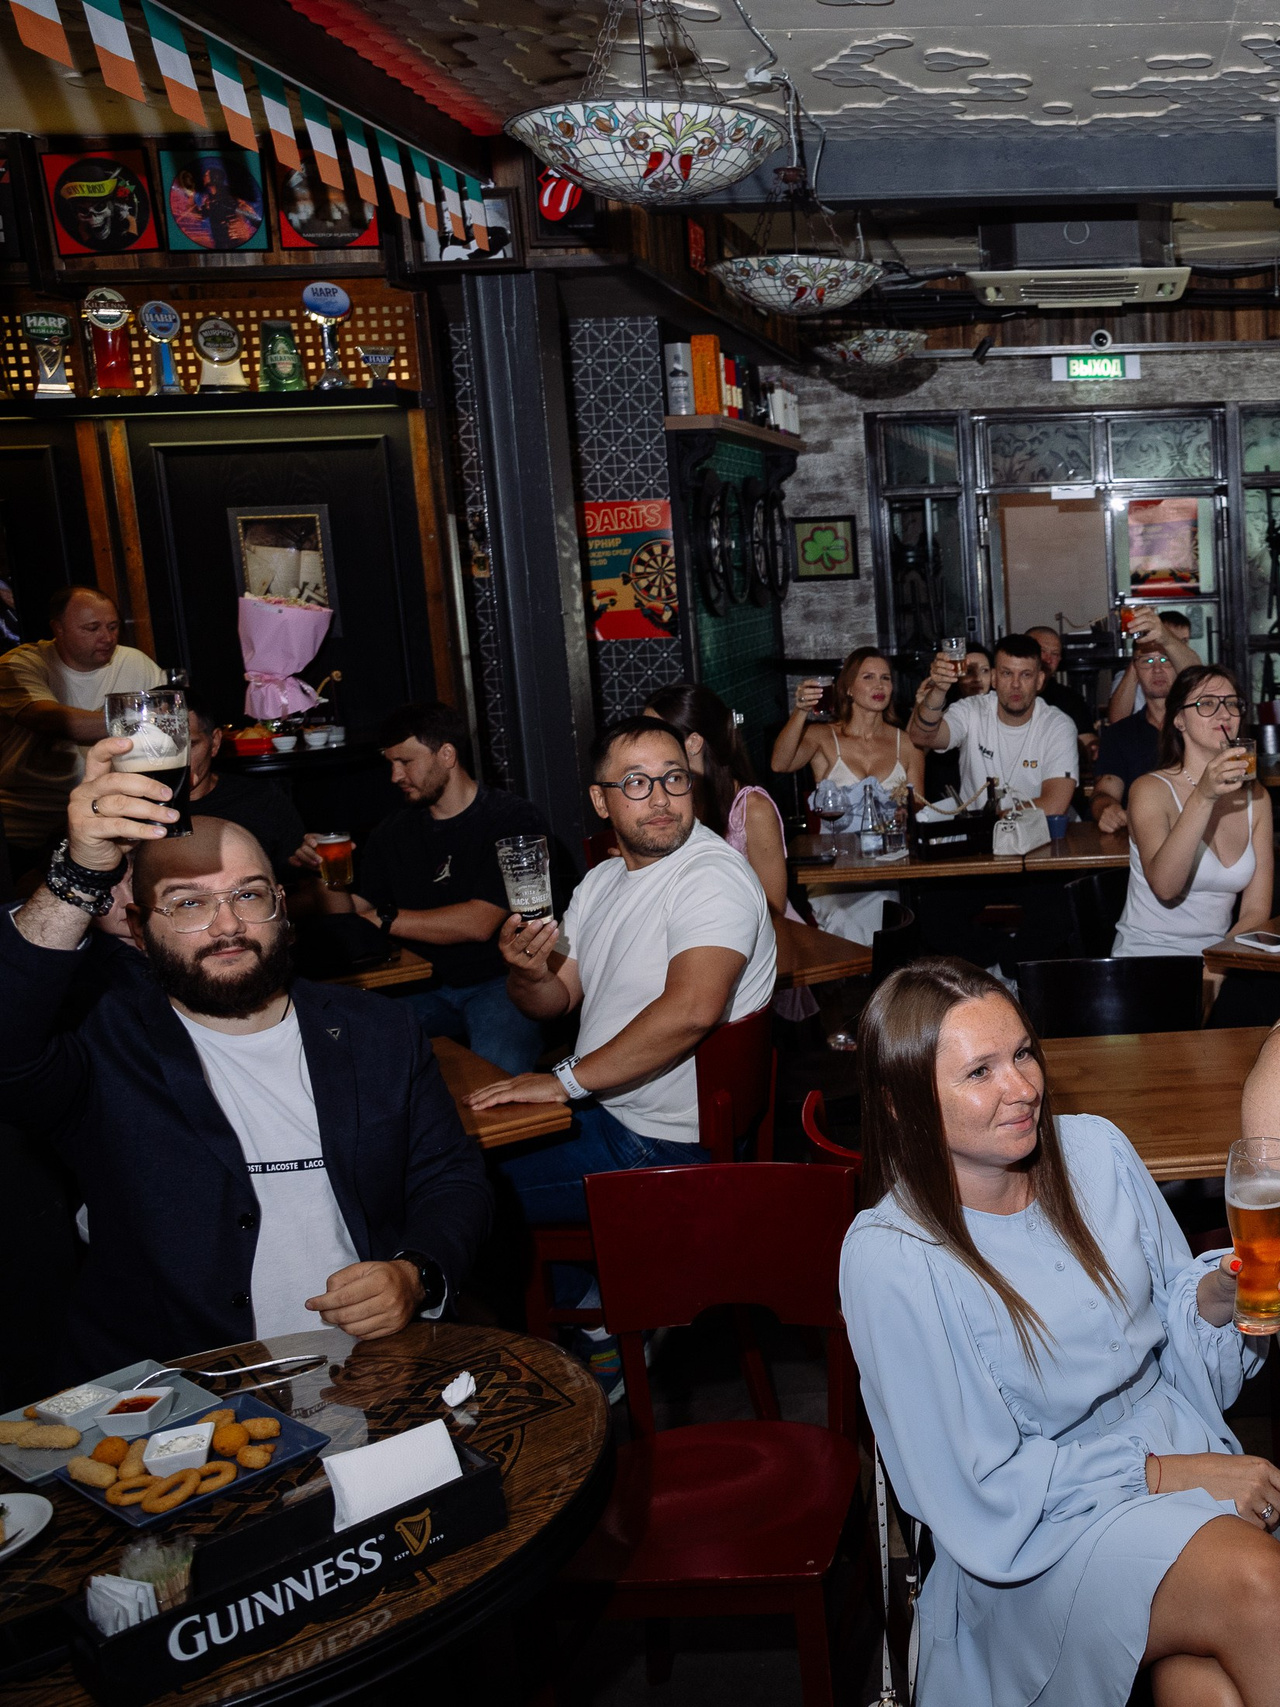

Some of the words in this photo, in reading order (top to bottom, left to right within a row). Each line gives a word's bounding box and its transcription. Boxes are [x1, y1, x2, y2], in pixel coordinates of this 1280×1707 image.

[311, 287, 338, 297] HARP
[83, 300, 129, 309] KILKENNY
[26, 315, 68, 328] HARP
[145, 312, 176, 323] HARP
[1069, 359, 1122, 377] ВЫХОД
[585, 503, 662, 534] DARTS
[266, 1161, 299, 1172] LACOSTE
[428, 1533, 445, 1545] 1759
[167, 1536, 383, 1662] GUINNESS
